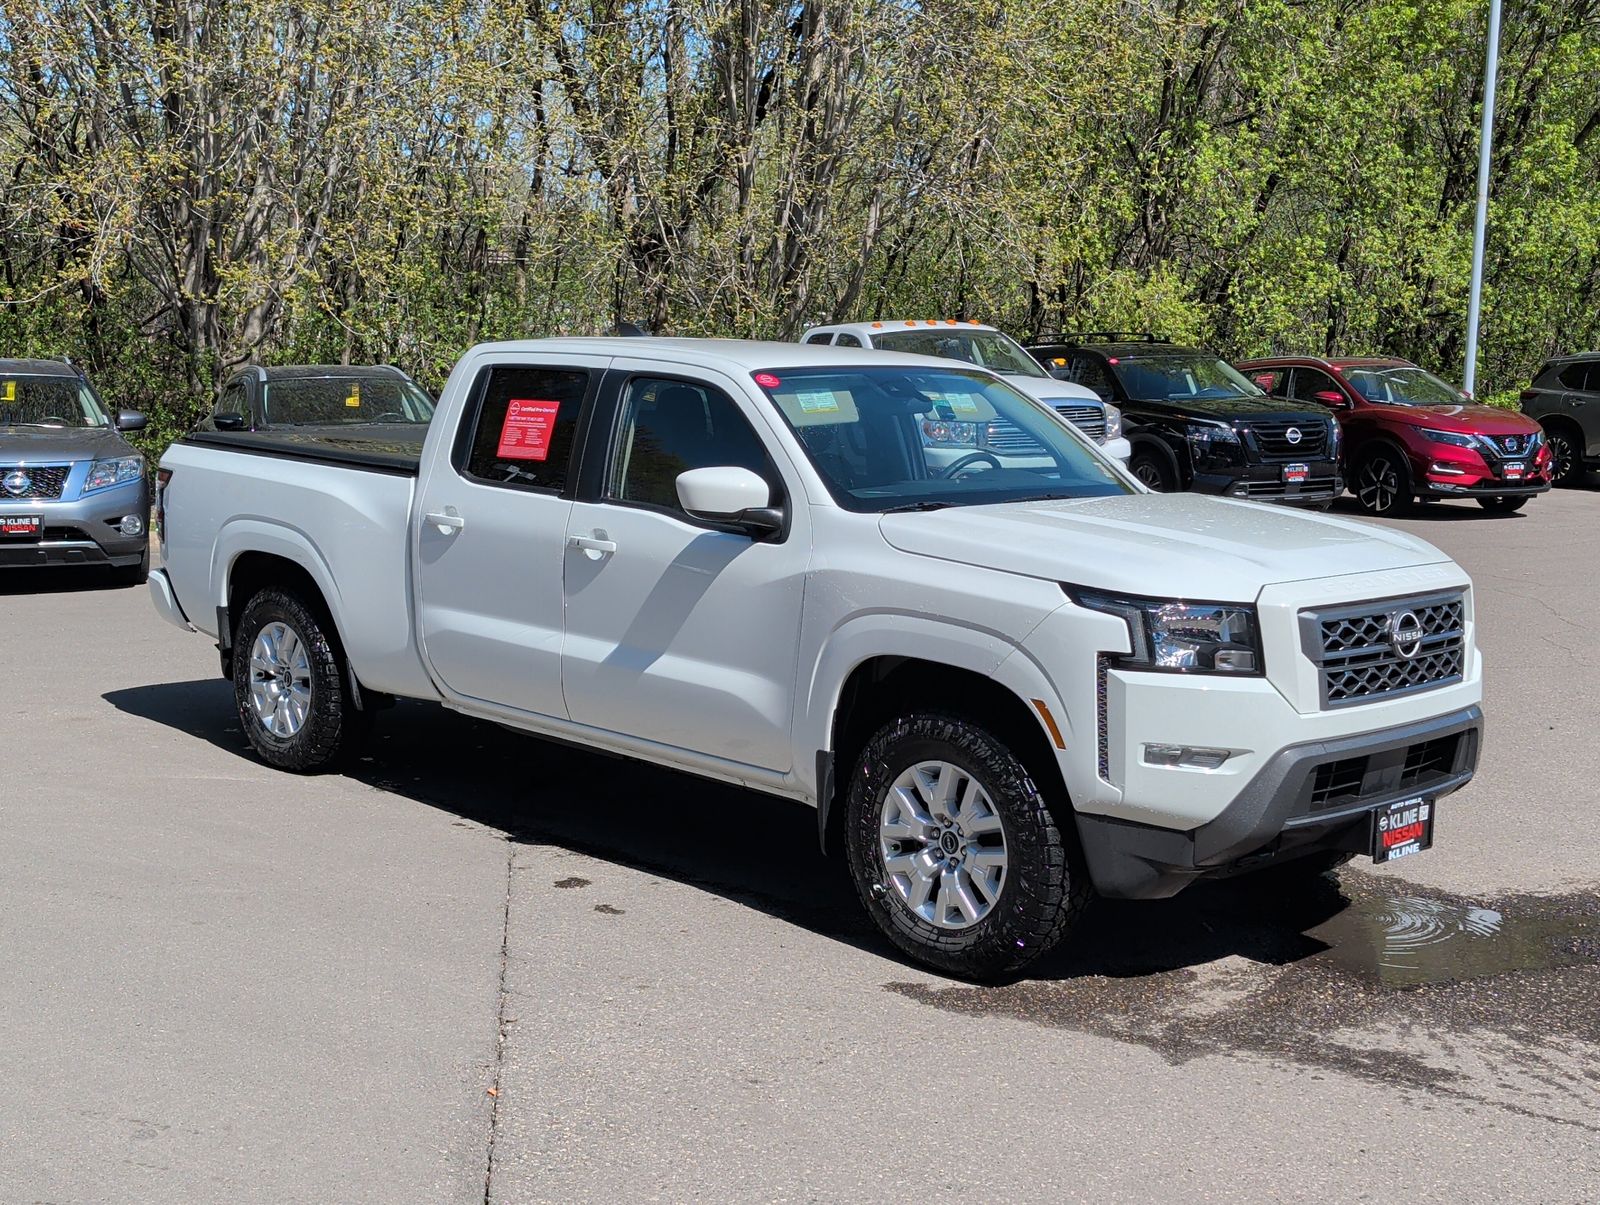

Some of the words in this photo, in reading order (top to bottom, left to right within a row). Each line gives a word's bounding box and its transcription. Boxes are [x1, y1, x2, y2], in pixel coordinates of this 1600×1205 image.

[1390, 808, 1418, 830] KLINE
[1383, 822, 1423, 848] NISSAN
[1388, 843, 1420, 860] KLINE
